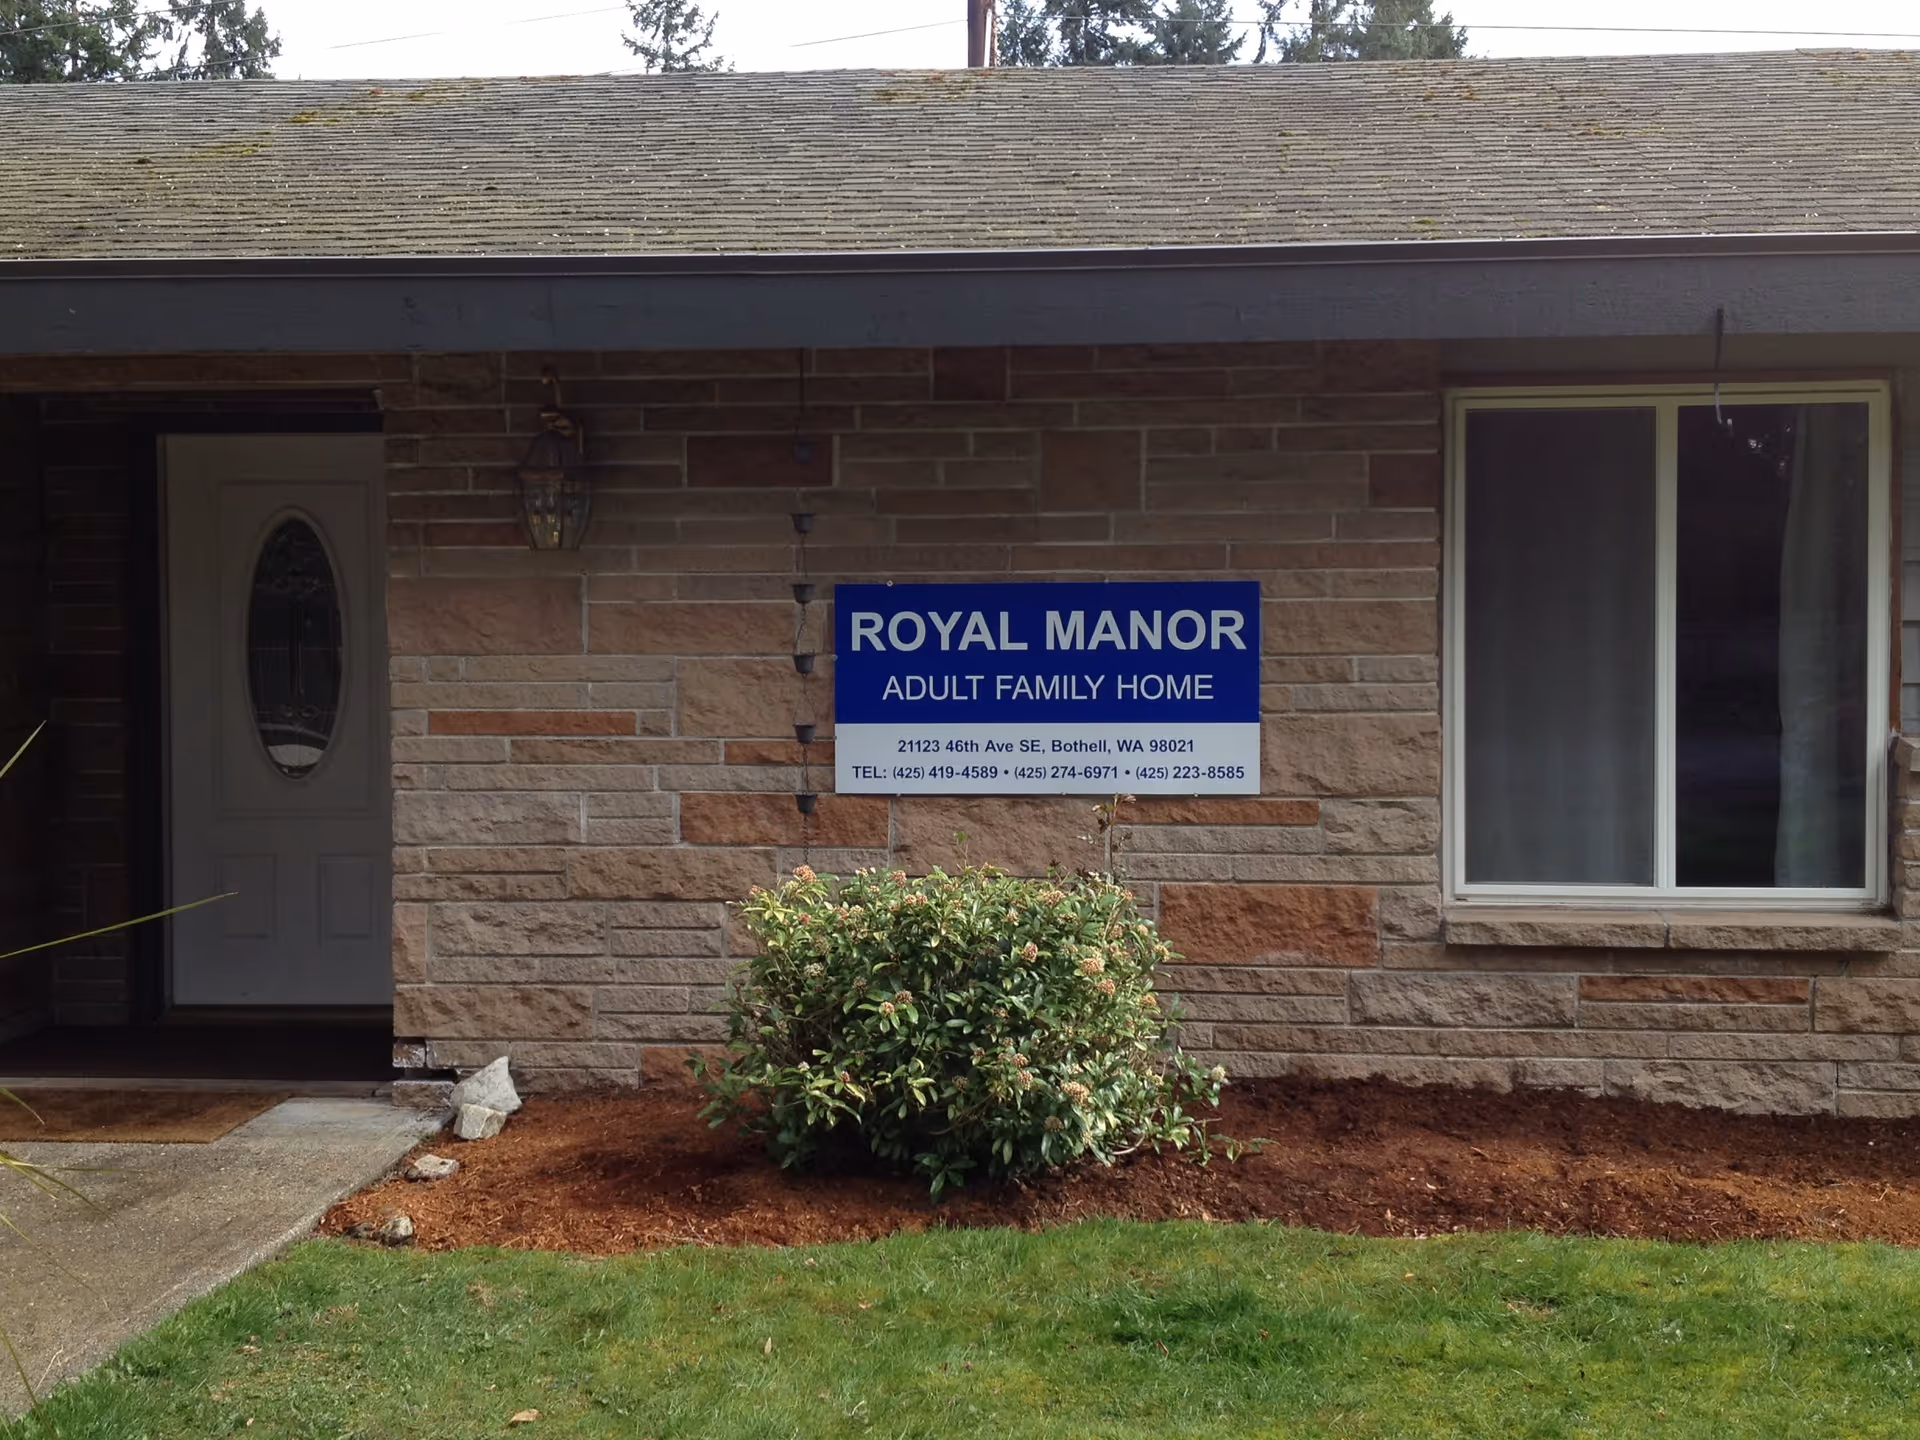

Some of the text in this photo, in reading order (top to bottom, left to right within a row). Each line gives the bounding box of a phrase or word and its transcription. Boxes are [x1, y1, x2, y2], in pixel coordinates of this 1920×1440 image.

[852, 610, 1246, 651] ROYAL MANOR
[883, 675, 1213, 700] ADULT FAMILY HOME
[898, 740, 1193, 754] 21123 46th Ave SE, Bothell, WA 98021
[852, 766, 1244, 780] TEL: (425) 419-4589 (425) 274-6971 (425) 223-8585
